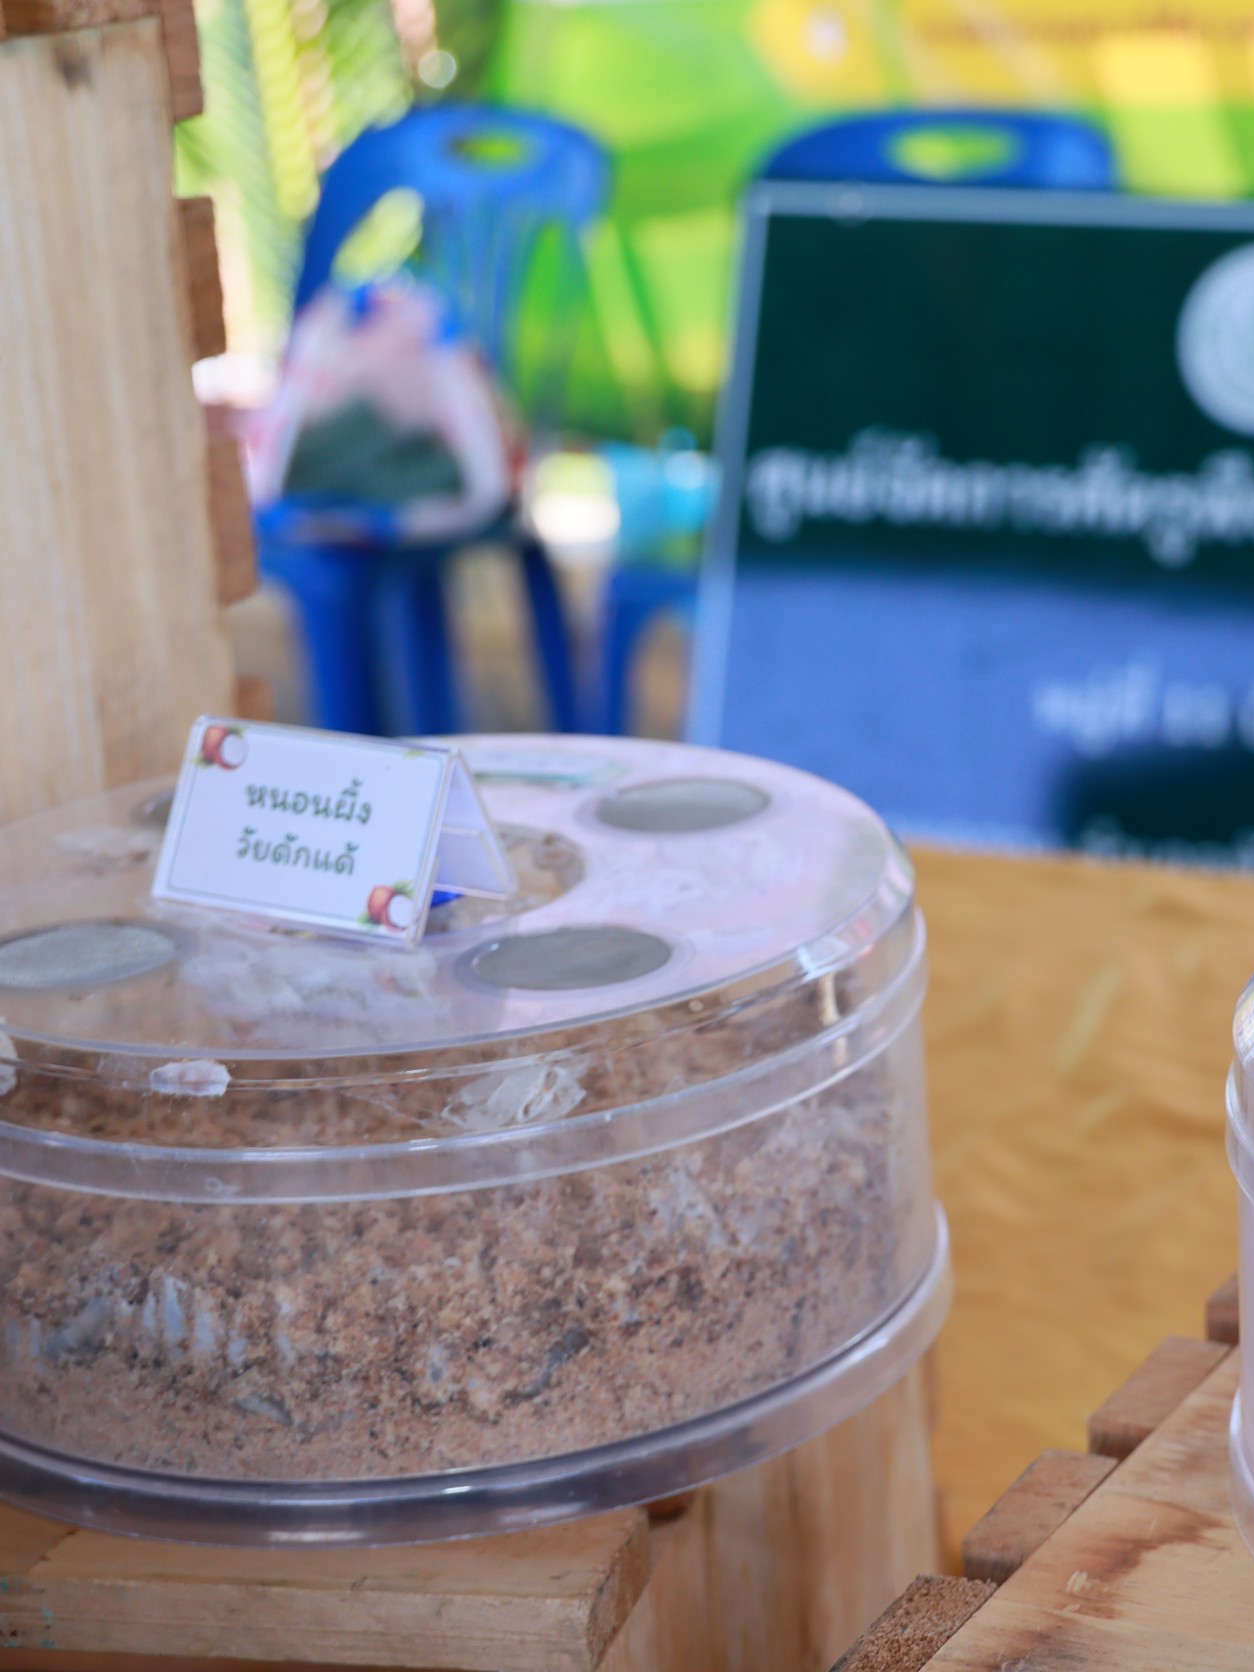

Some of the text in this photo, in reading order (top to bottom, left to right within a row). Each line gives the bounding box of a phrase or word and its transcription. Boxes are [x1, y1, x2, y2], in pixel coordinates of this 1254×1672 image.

[244, 778, 373, 826] หนอนผึ้ง
[235, 826, 358, 876] วัยดักแด้
